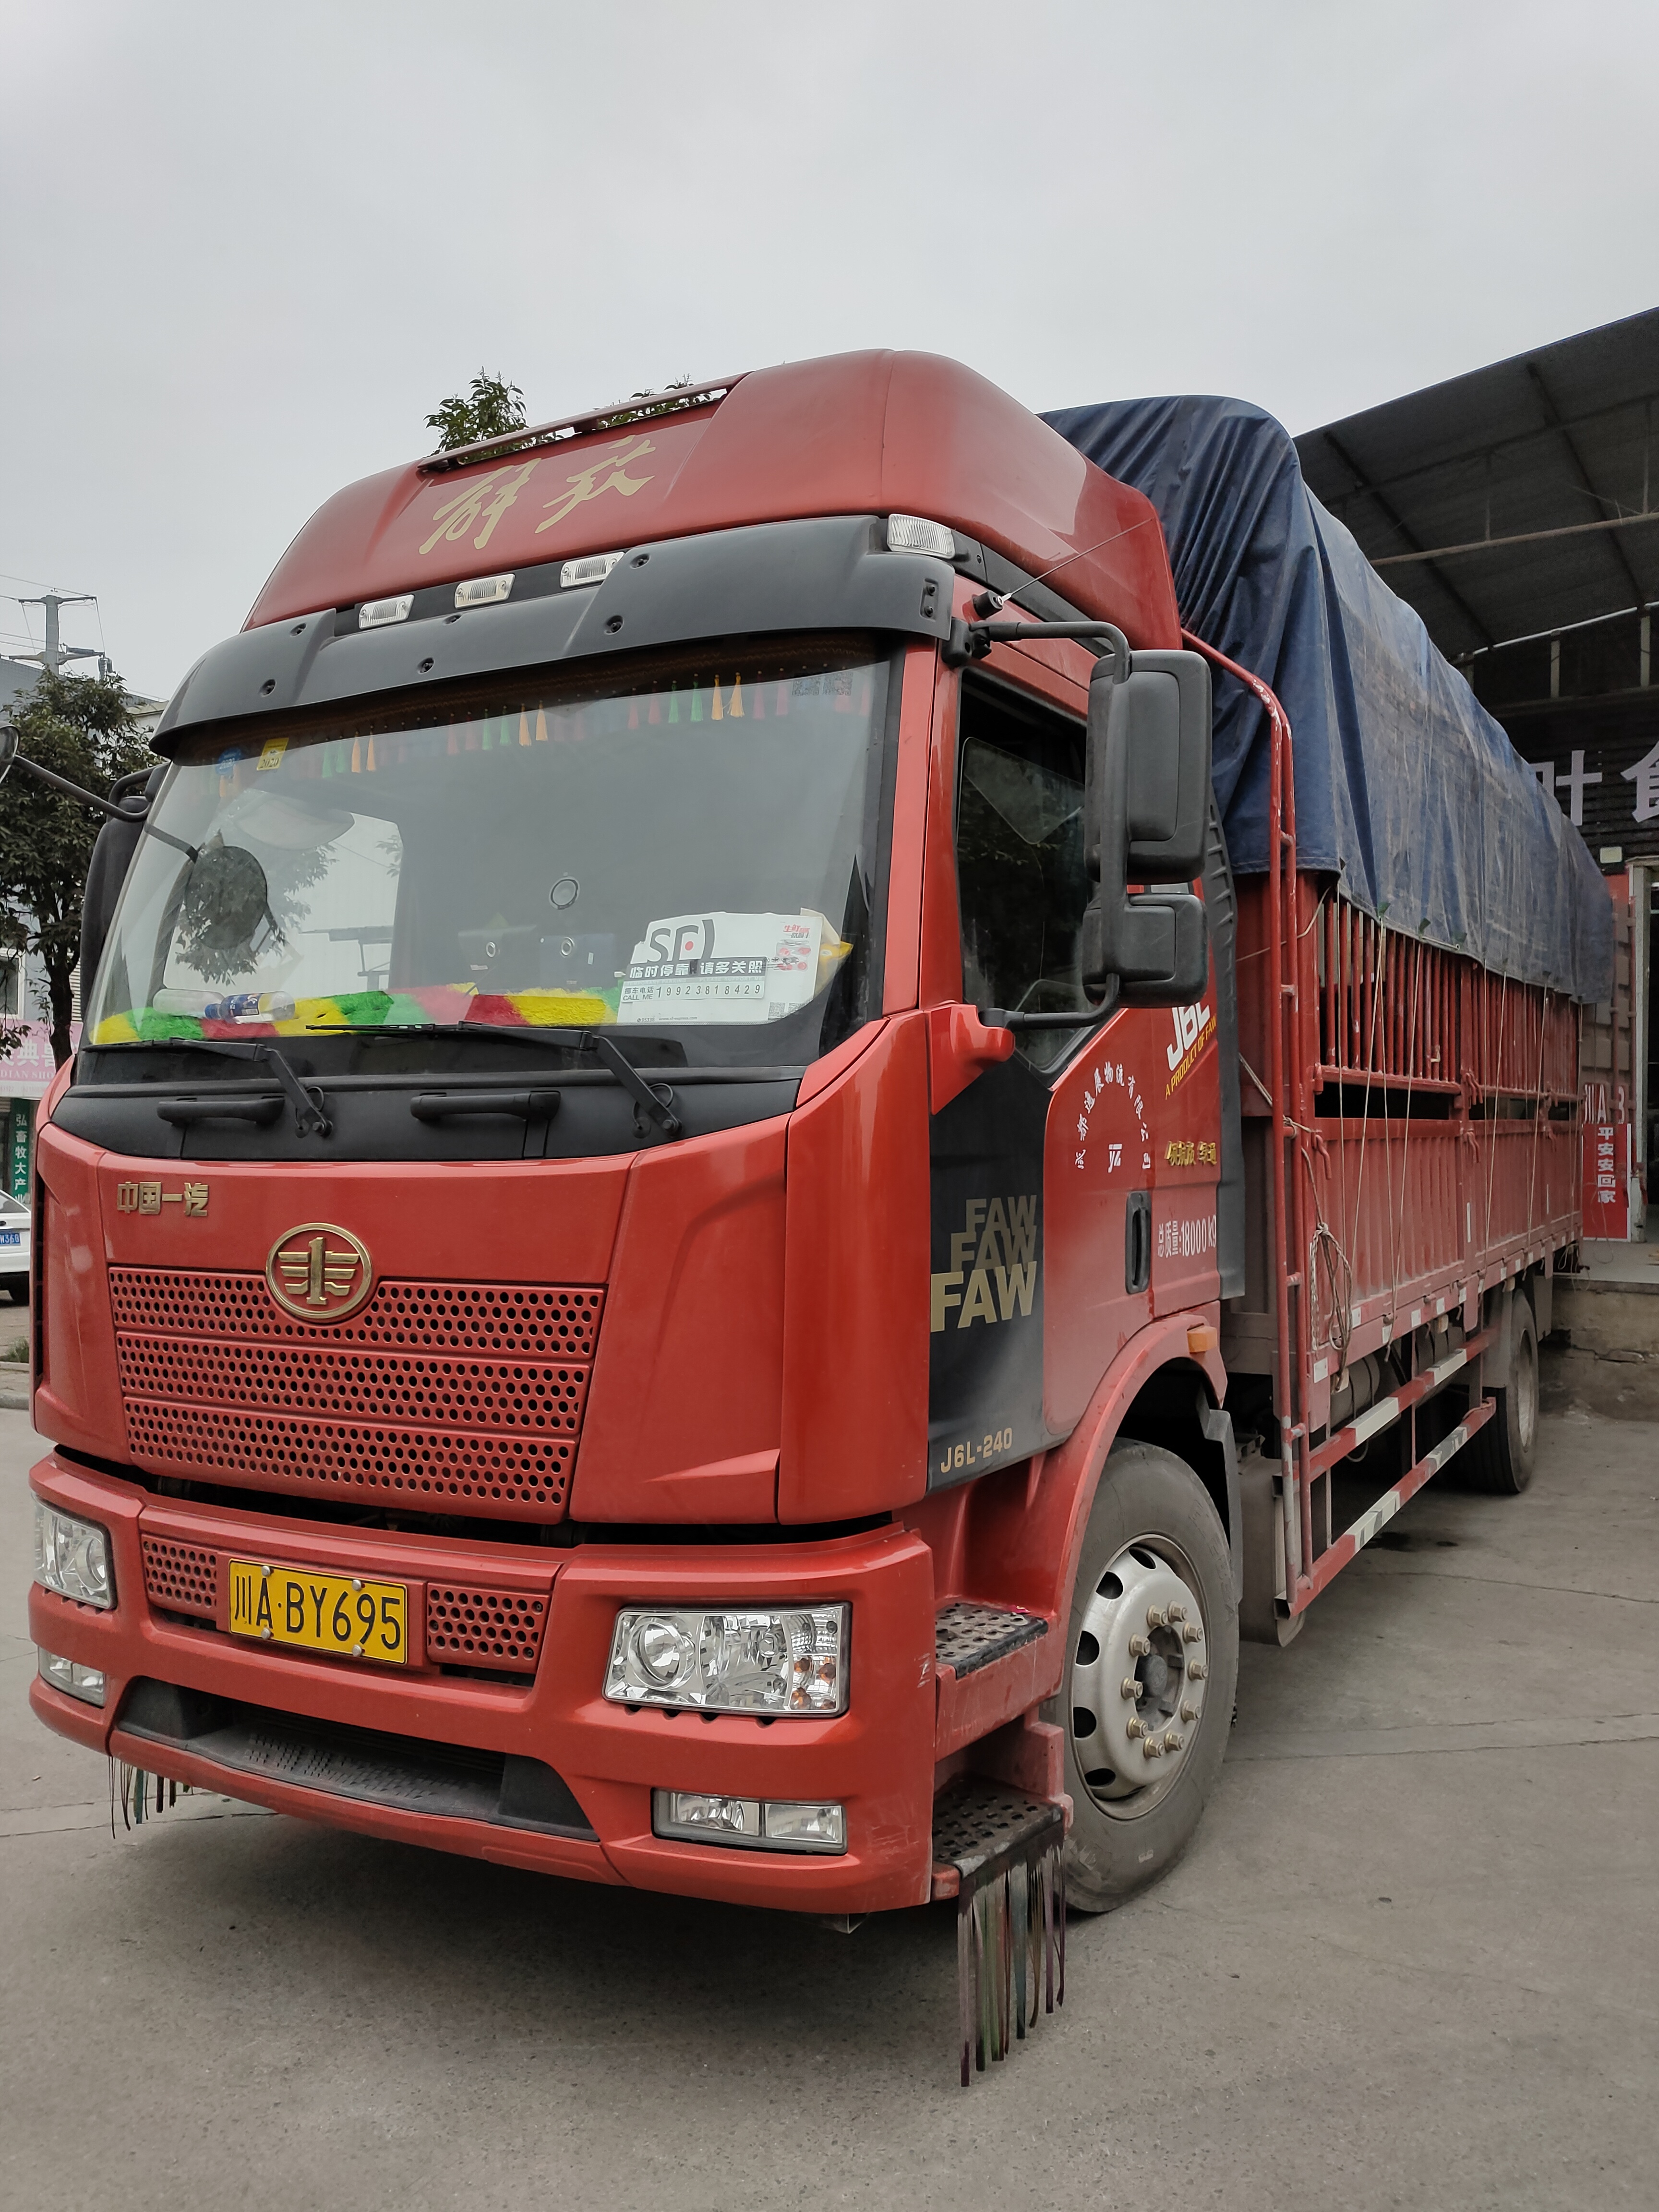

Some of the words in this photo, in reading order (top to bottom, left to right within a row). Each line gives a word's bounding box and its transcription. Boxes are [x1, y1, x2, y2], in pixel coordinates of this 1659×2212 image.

[419, 435, 656, 555] 解放
[260, 758, 279, 769] 2020
[624, 986, 654, 995] 挪车电话
[630, 963, 689, 978] 临时停靠
[700, 961, 762, 975] 请多关照
[1165, 1084, 1171, 1100] A
[1171, 1042, 1197, 1093] PRODUCT
[1198, 1032, 1205, 1052] OF
[1598, 1127, 1616, 1203] 平安安回家
[117, 1181, 209, 1216] 中国一汽
[966, 1195, 1037, 1235] FAW
[950, 1225, 1037, 1276] FAW
[930, 1261, 1037, 1333] FAW
[941, 1428, 1012, 1474] J6L-240
[234, 1575, 400, 1650] 川A·BY695
